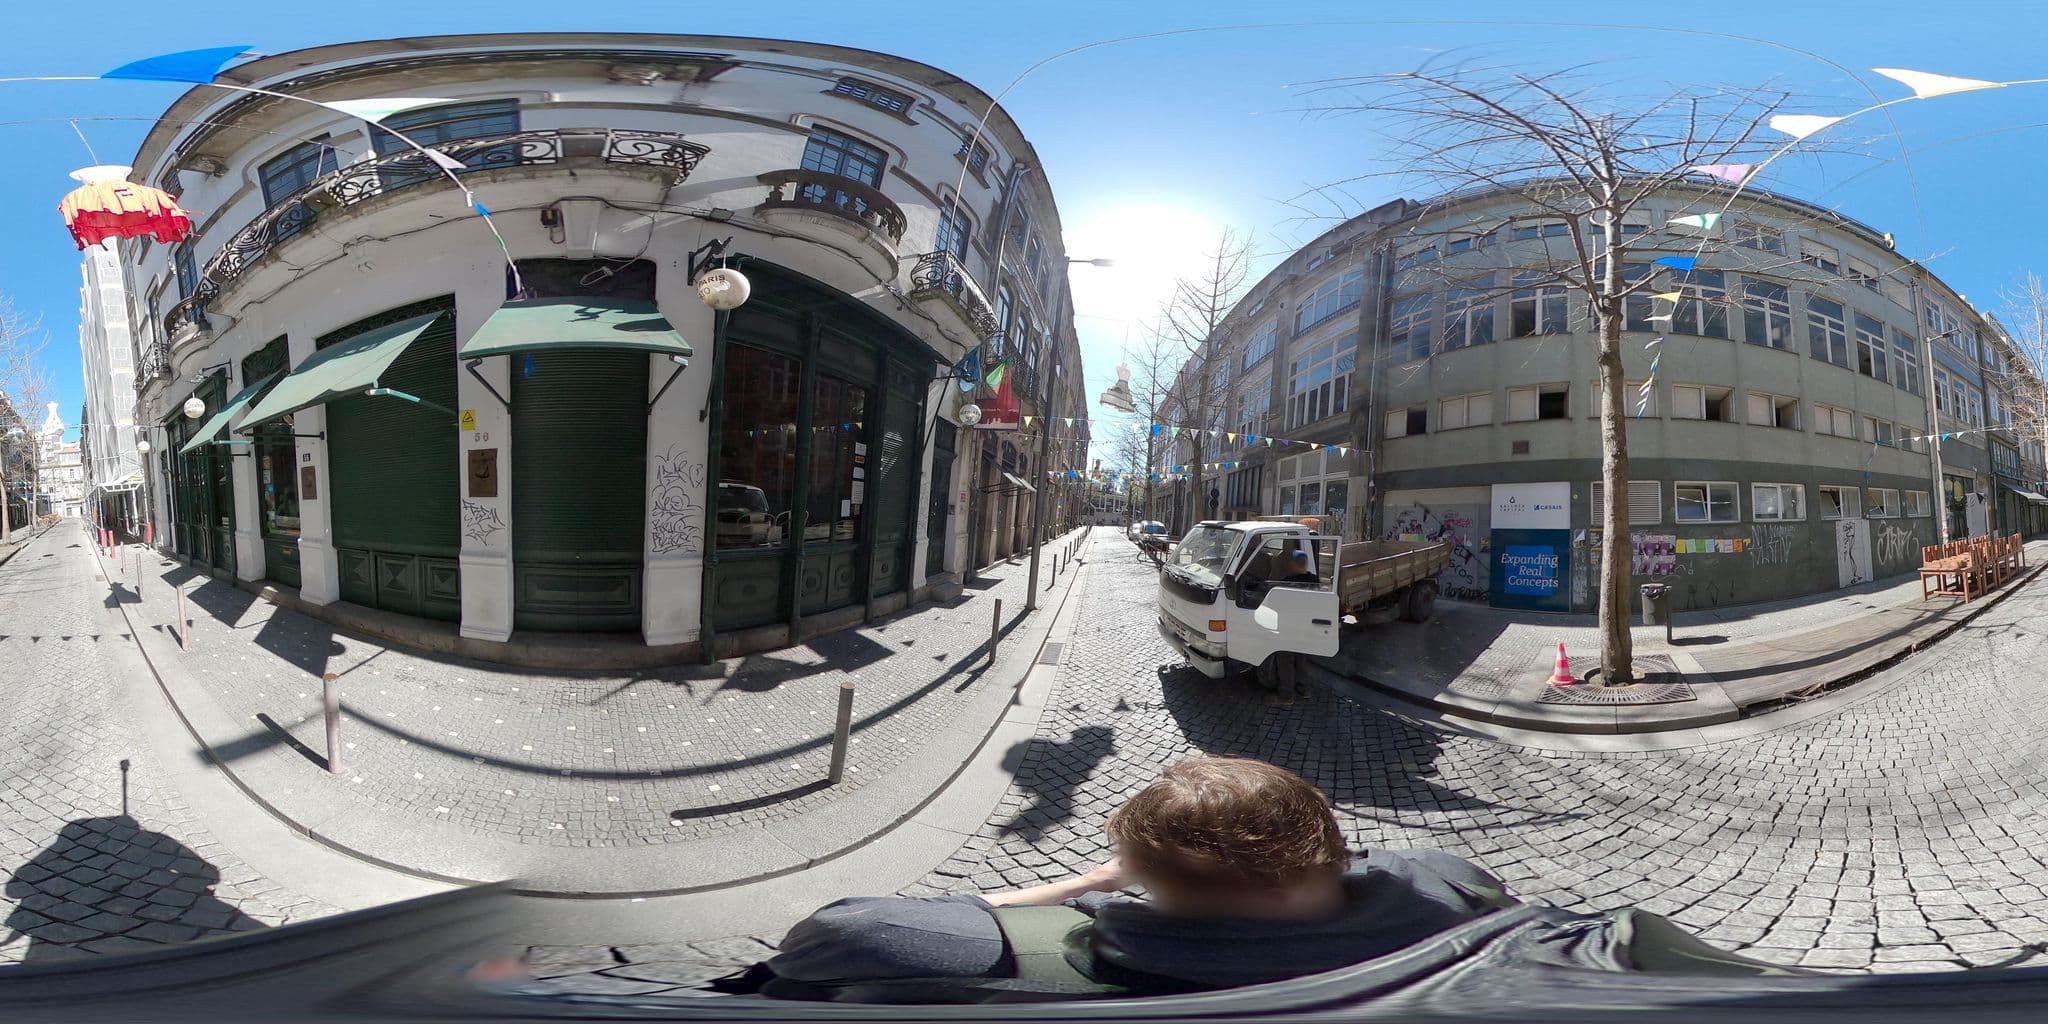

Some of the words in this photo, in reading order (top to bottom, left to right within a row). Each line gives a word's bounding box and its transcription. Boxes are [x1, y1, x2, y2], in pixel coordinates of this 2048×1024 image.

[698, 274, 726, 288] PARIS
[1501, 553, 1559, 569] Expanding
[1518, 564, 1543, 576] Real
[1508, 576, 1559, 590] Concepts
